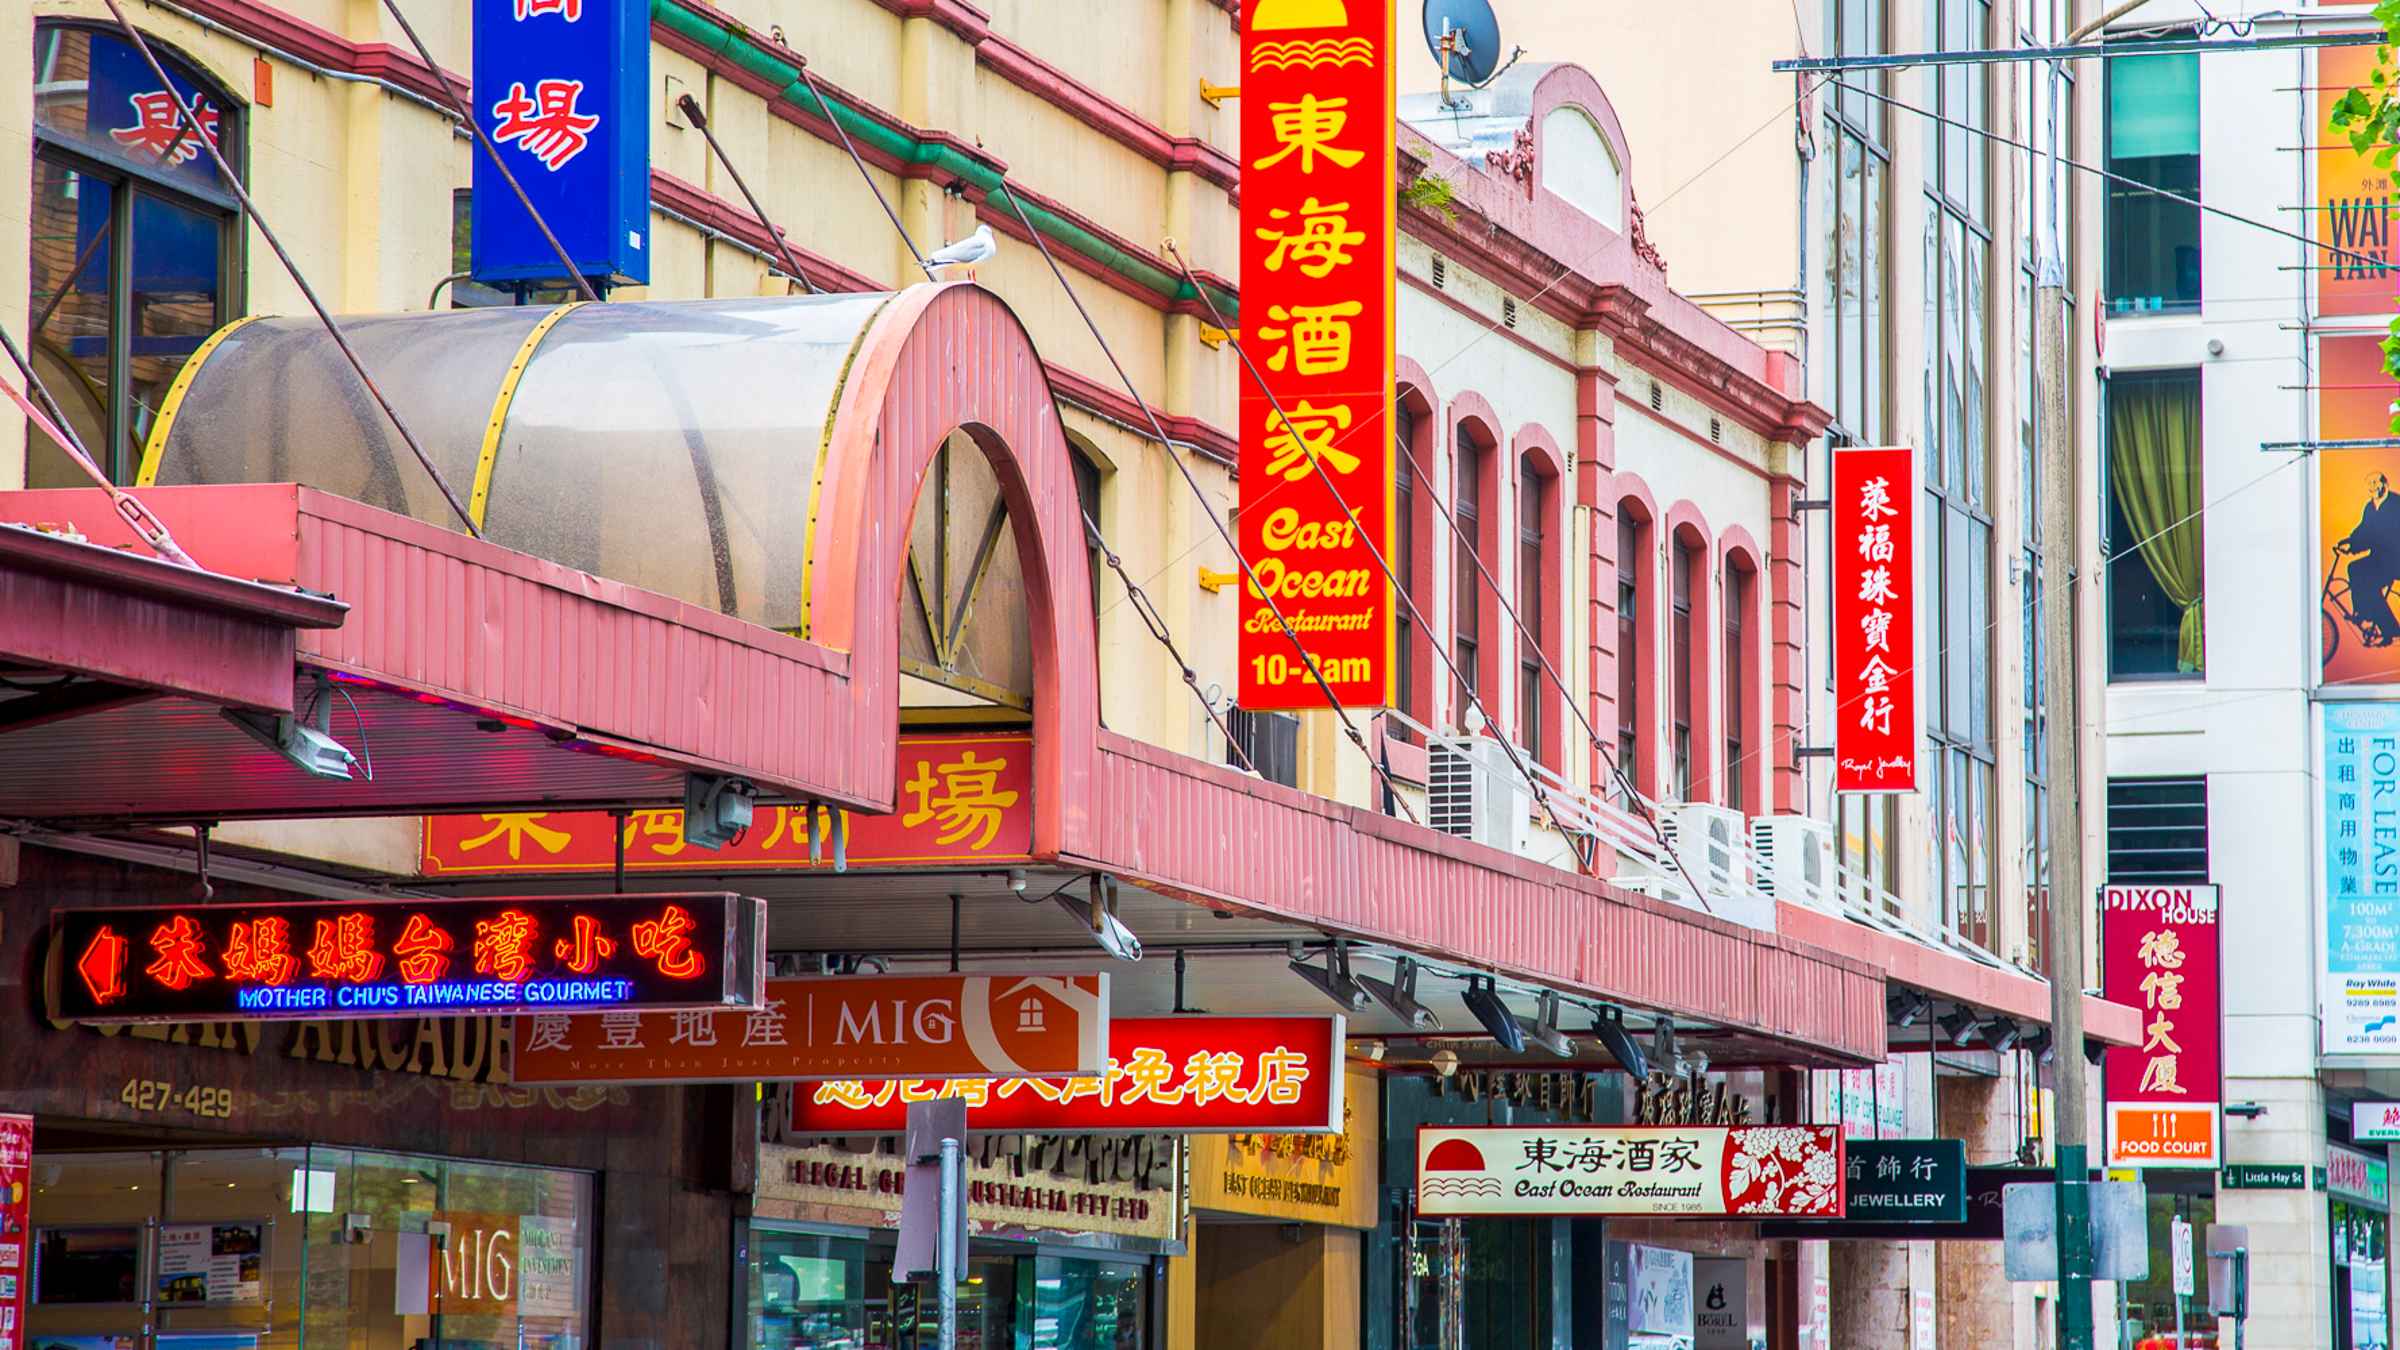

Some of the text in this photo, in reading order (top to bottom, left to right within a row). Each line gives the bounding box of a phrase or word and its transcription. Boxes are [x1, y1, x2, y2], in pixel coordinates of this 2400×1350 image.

[2329, 196, 2389, 248] WAI
[2329, 250, 2388, 280] TAN
[1252, 93, 1367, 482] 東海酒家
[1261, 507, 1361, 551] East
[1247, 556, 1370, 600] Ocean
[1245, 606, 1374, 635] Restaurant
[1251, 653, 1371, 687] 10-2am
[2372, 737, 2398, 894] FOR LEASE
[2107, 888, 2192, 910] DIXON
[2162, 908, 2215, 924] HOUSE
[239, 980, 627, 1008] MOTHER CHU'S TAIWANESE GOURMET
[2367, 978, 2397, 988] White
[832, 998, 957, 1045] MIG
[1515, 1136, 1703, 1173] 東海酒家
[2121, 1140, 2208, 1154] FOOD COURT
[1515, 1179, 1703, 1198] East Ocean Restaurant
[2245, 1171, 2269, 1182] Little
[2271, 1171, 2290, 1185] Hay
[970, 1180, 1068, 1213] USTRALIA
[1850, 1193, 1946, 1208] JEWELLERY
[435, 1229, 512, 1301] MIG
